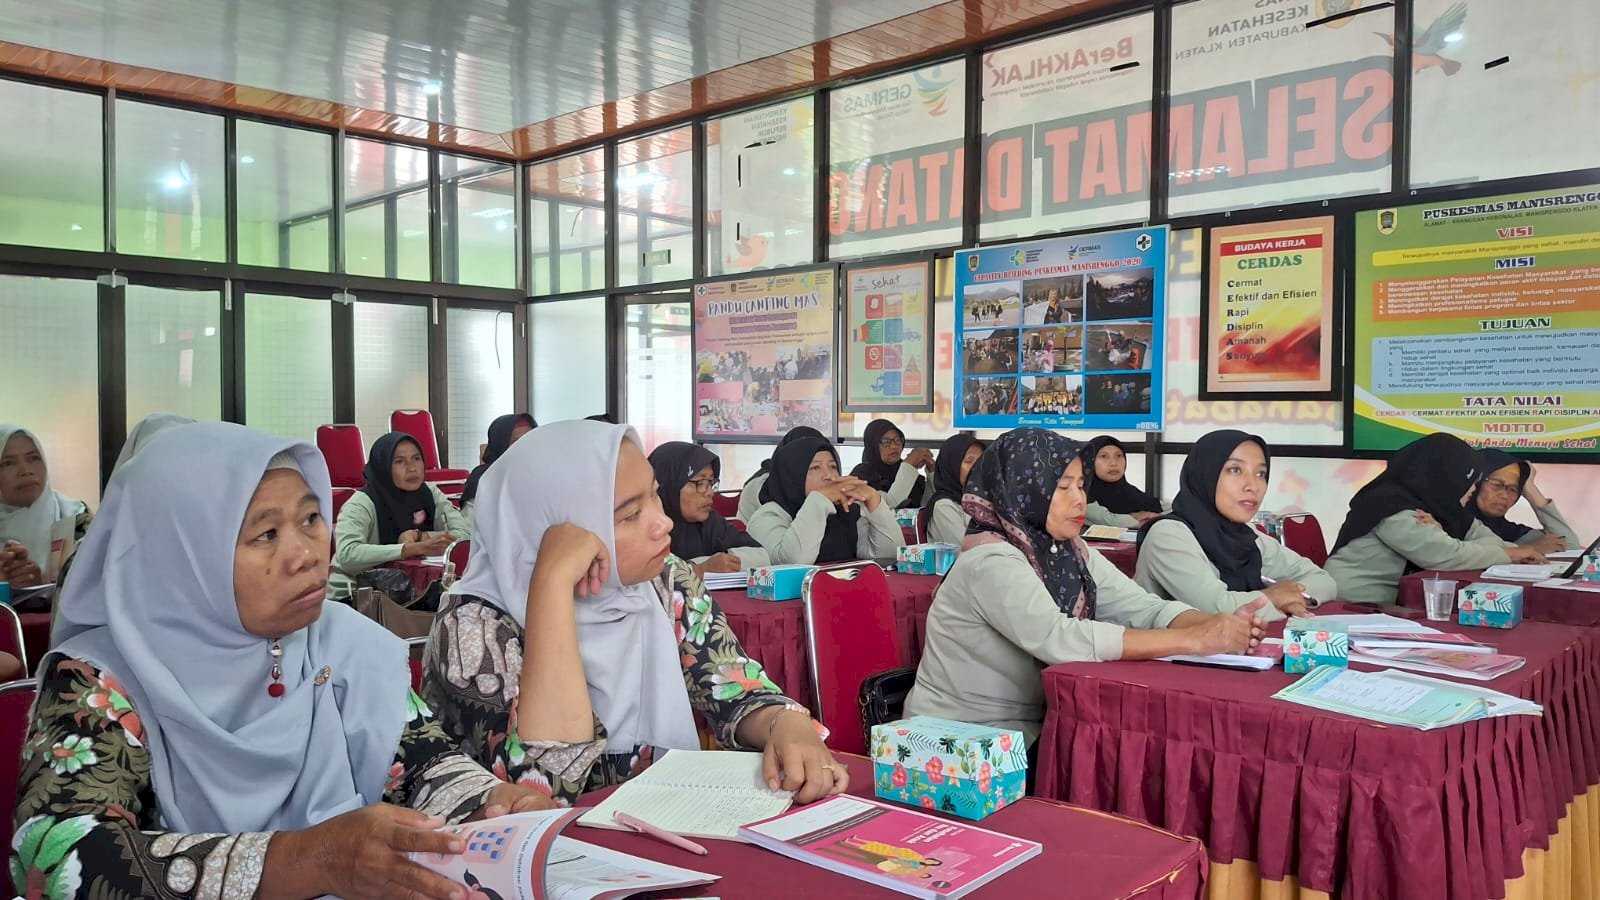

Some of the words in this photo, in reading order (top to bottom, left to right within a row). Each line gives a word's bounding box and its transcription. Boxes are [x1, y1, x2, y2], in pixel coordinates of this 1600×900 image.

[1423, 201, 1505, 220] PUSKESMAS
[1497, 226, 1534, 239] VISI
[1235, 241, 1274, 253] BUDAYA
[1275, 238, 1307, 249] KERJA
[1237, 254, 1303, 271] CERDAS
[1495, 256, 1536, 269] MISI
[1227, 278, 1263, 288] Cermat
[794, 292, 819, 309] MAS
[1227, 293, 1259, 303] Efektif
[1261, 291, 1280, 301] dan
[1282, 289, 1317, 299] Efisien
[1227, 307, 1249, 318] Rapi
[1226, 321, 1264, 332] Disiplin
[1479, 317, 1552, 331] TUJUAN
[1226, 336, 1267, 346] Amanah
[1464, 396, 1507, 407] TATA
[1513, 395, 1561, 406] NILAI
[1484, 423, 1545, 433] MOTTO
